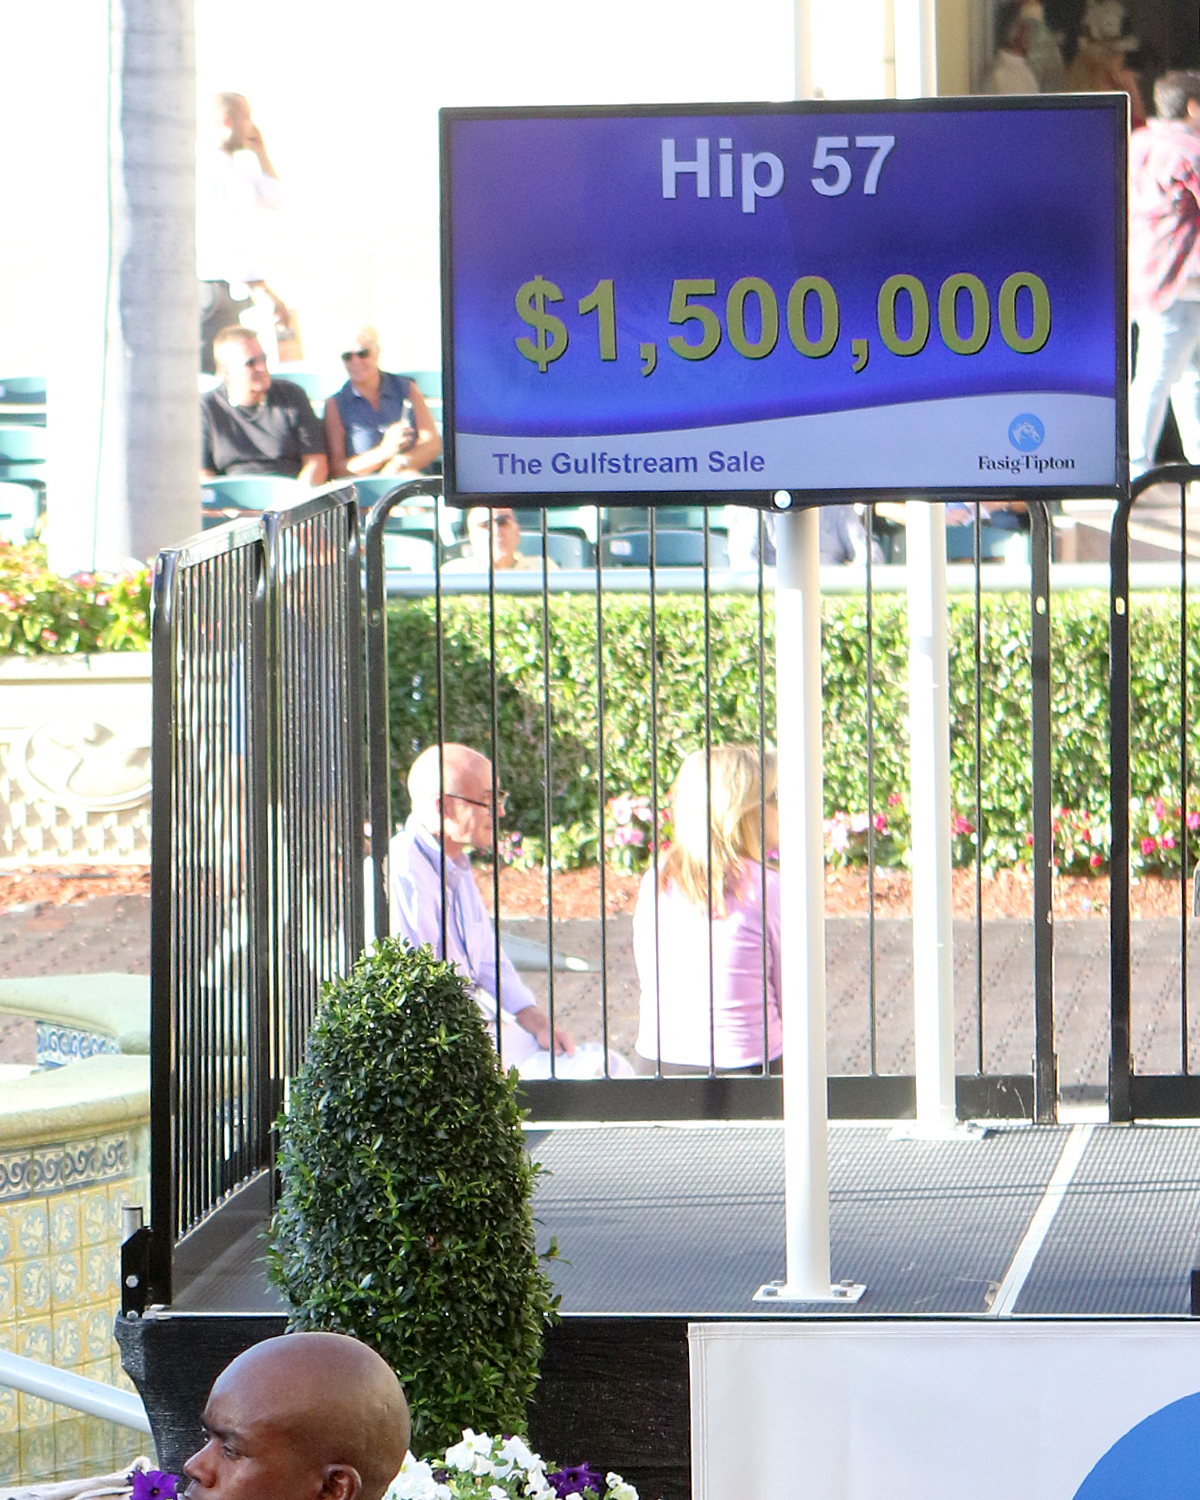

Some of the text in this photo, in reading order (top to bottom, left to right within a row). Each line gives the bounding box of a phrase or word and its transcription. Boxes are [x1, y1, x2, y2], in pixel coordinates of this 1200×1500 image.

[661, 135, 896, 213] Hip 57
[514, 271, 1053, 377] $1,500,000
[492, 450, 766, 475] The Gulfstream Sale
